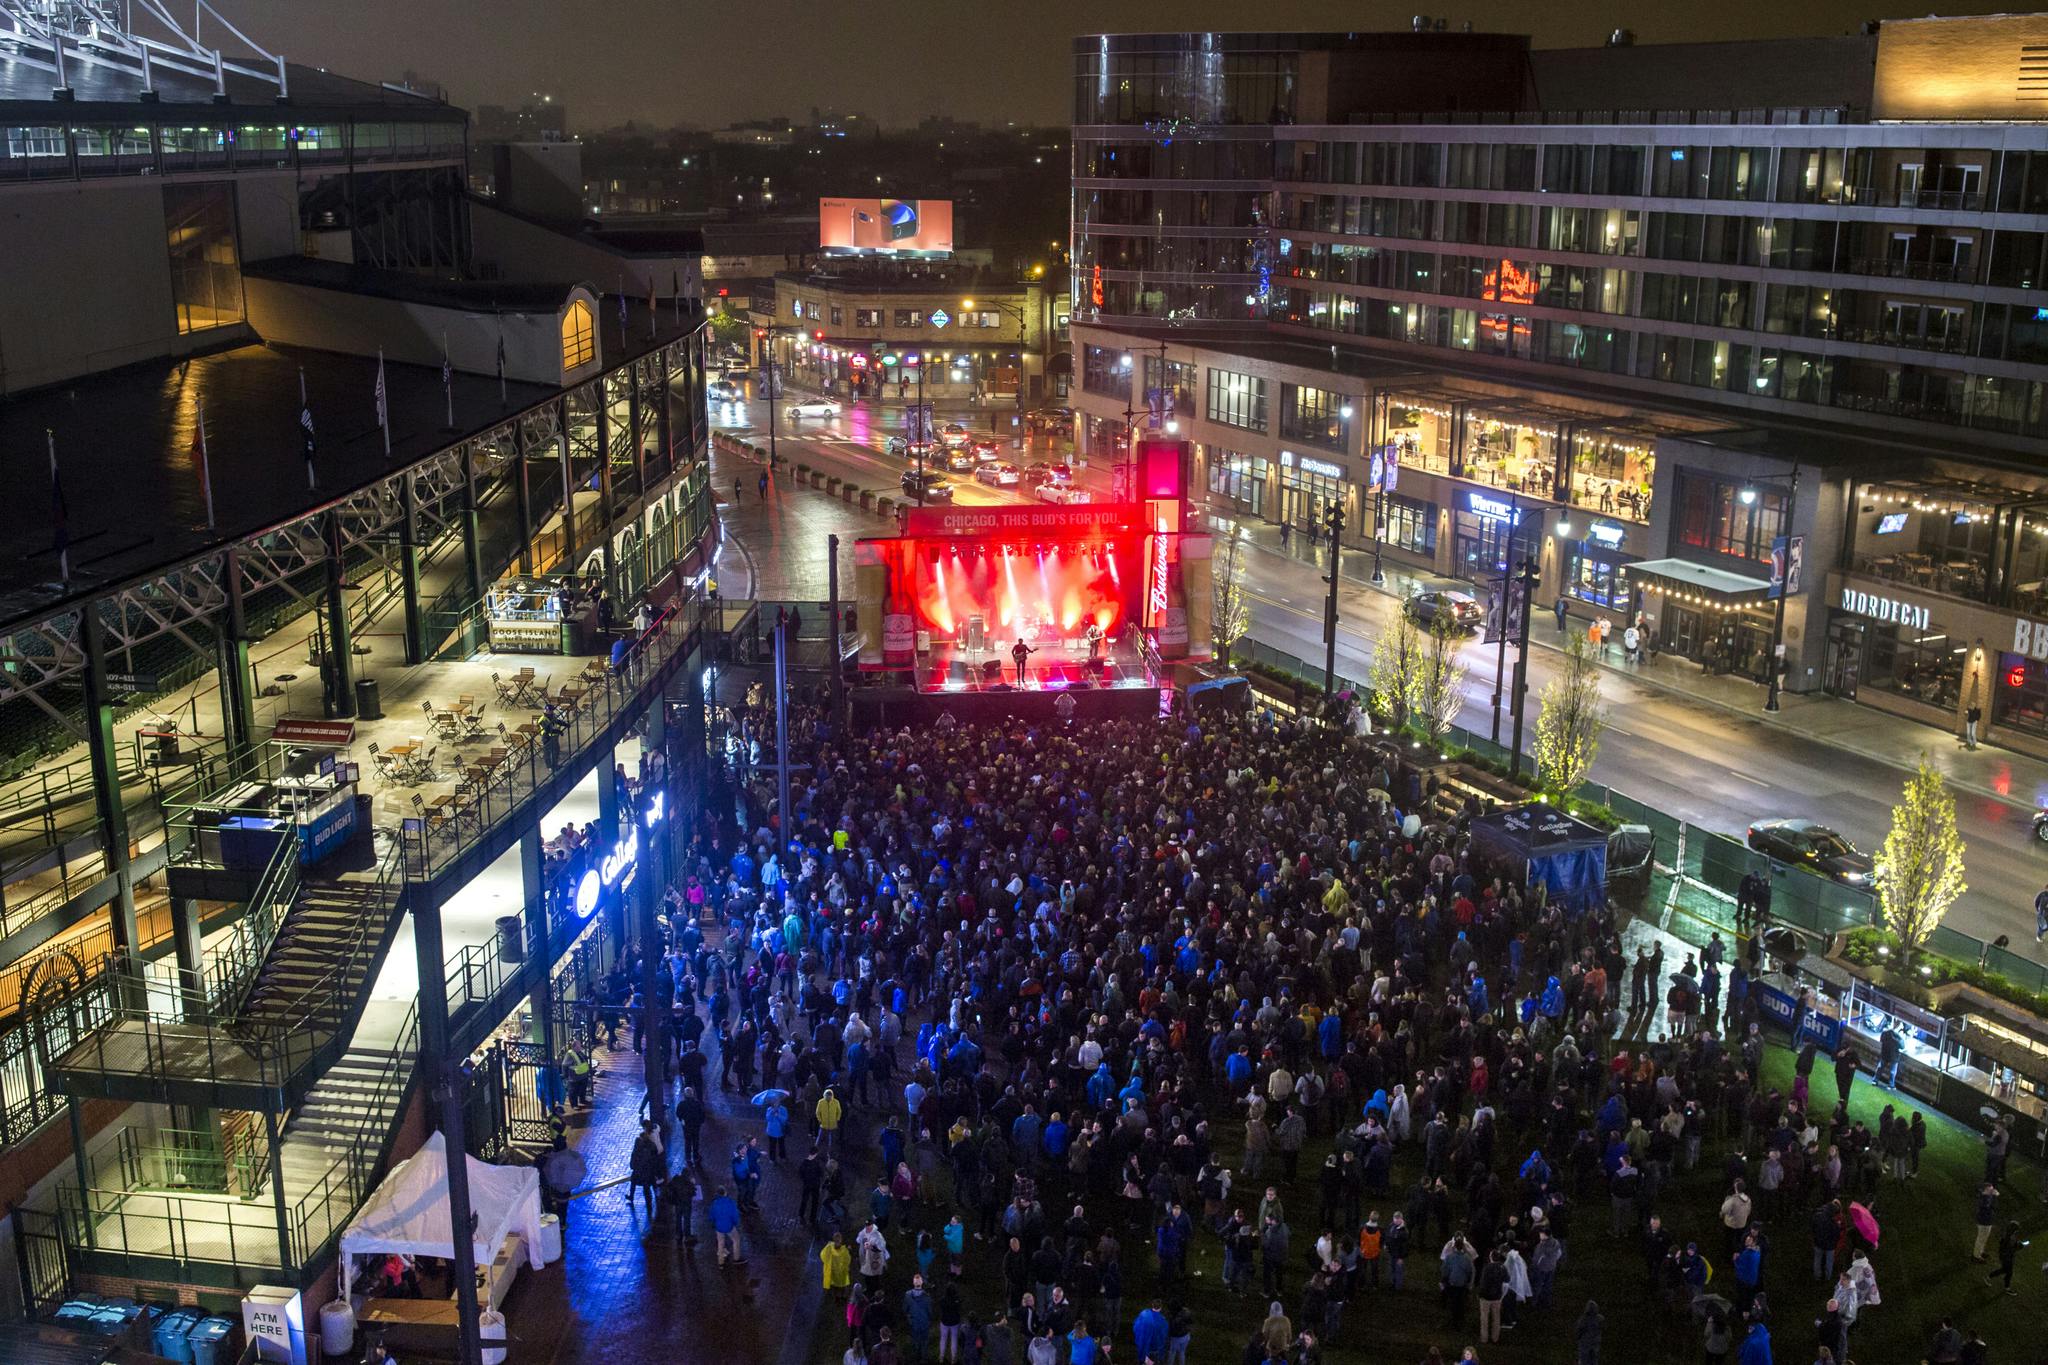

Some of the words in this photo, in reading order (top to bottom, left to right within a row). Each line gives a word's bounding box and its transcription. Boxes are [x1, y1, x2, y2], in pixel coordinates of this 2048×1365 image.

[944, 514, 999, 528] CHICAGO,
[1001, 514, 1029, 526] THIS
[1032, 513, 1066, 525] BUD'S
[1069, 513, 1093, 525] FOR
[1095, 512, 1121, 525] YOU.
[1841, 588, 1929, 630] MORDECAI
[314, 828, 331, 846] BUD
[330, 811, 352, 835] LIGHT
[1539, 822, 1573, 832] Gallagher
[601, 824, 638, 885] Gallag
[1762, 992, 1790, 1016] BUD
[253, 1312, 278, 1324] ATM
[250, 1323, 283, 1336] HERE
